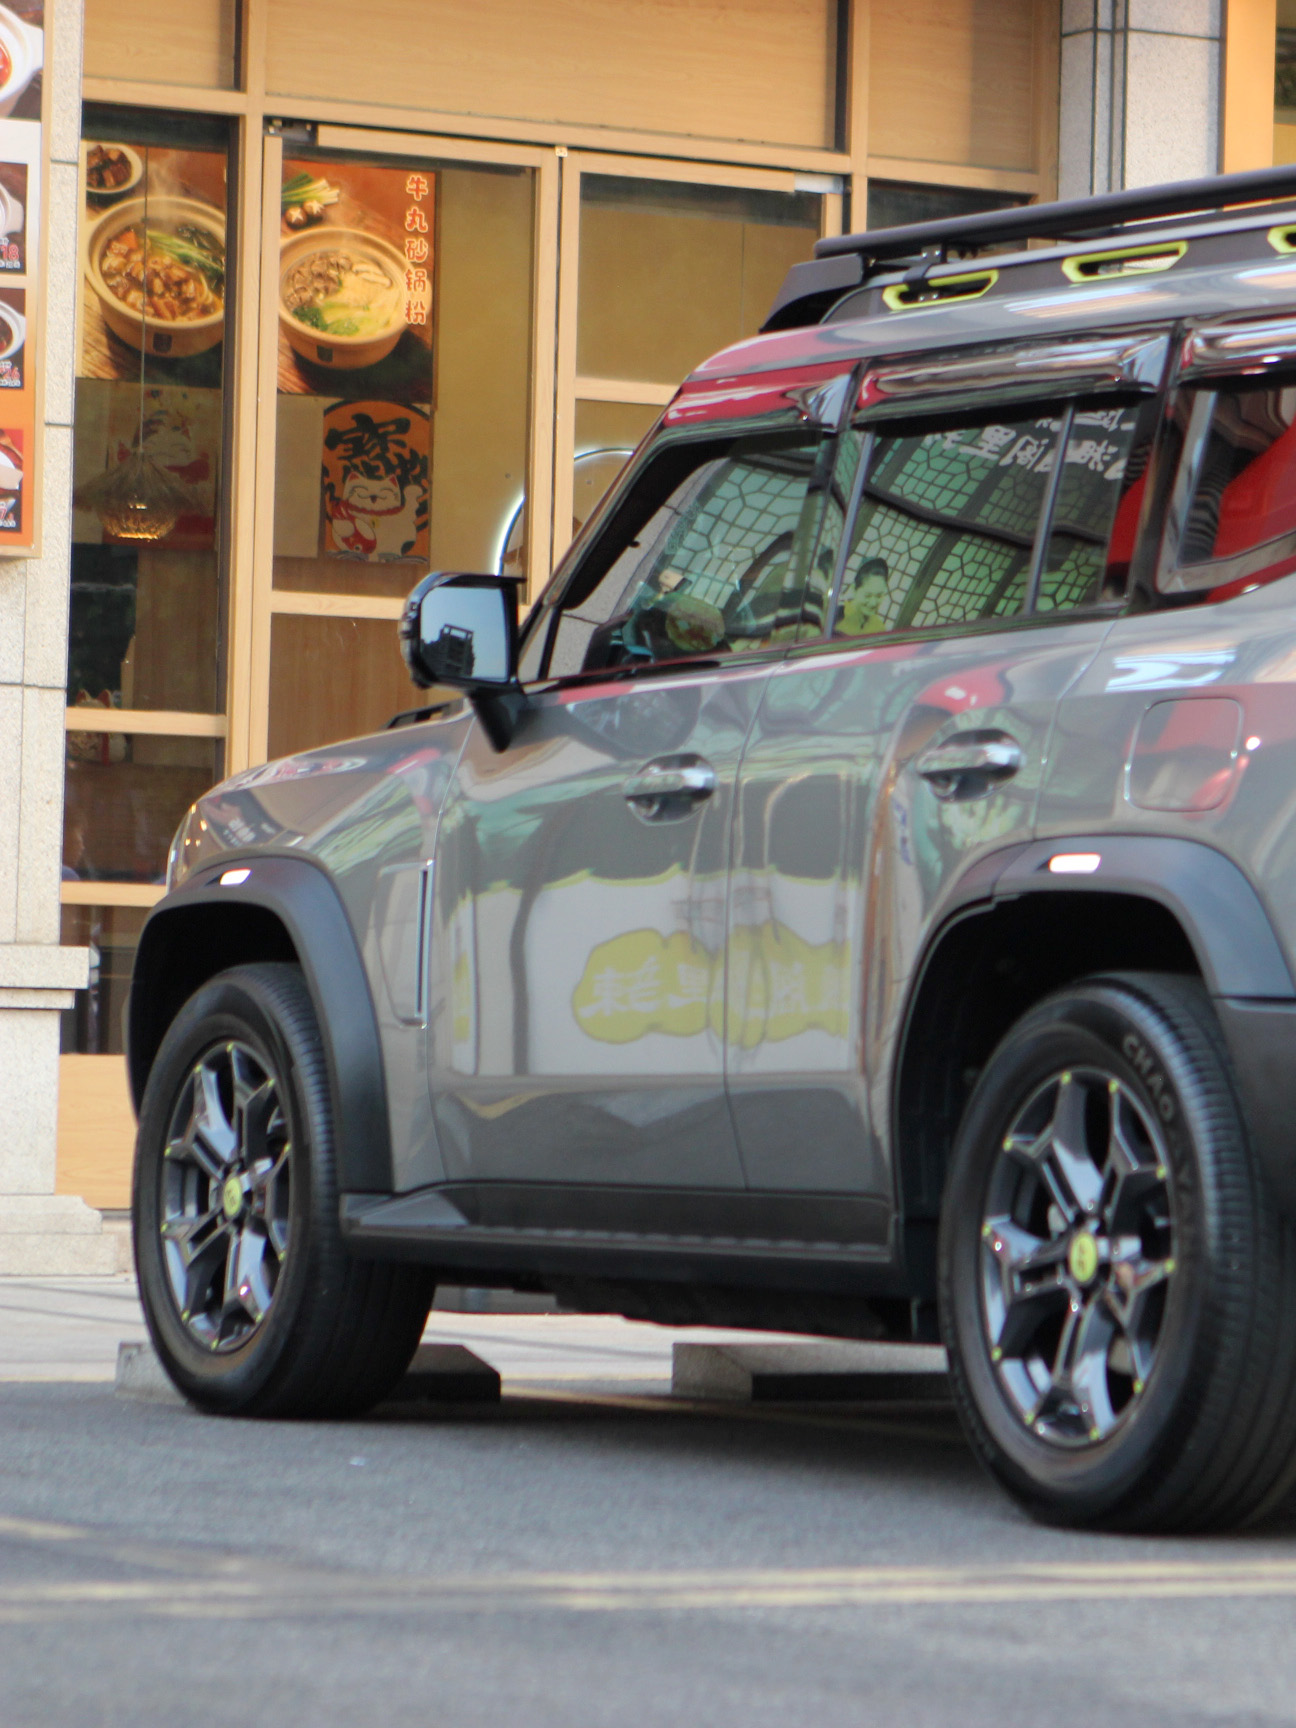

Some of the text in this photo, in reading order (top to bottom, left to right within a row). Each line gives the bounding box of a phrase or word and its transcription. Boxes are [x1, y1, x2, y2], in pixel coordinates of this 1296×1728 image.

[405, 175, 428, 325] 牛丸砂锅粉
